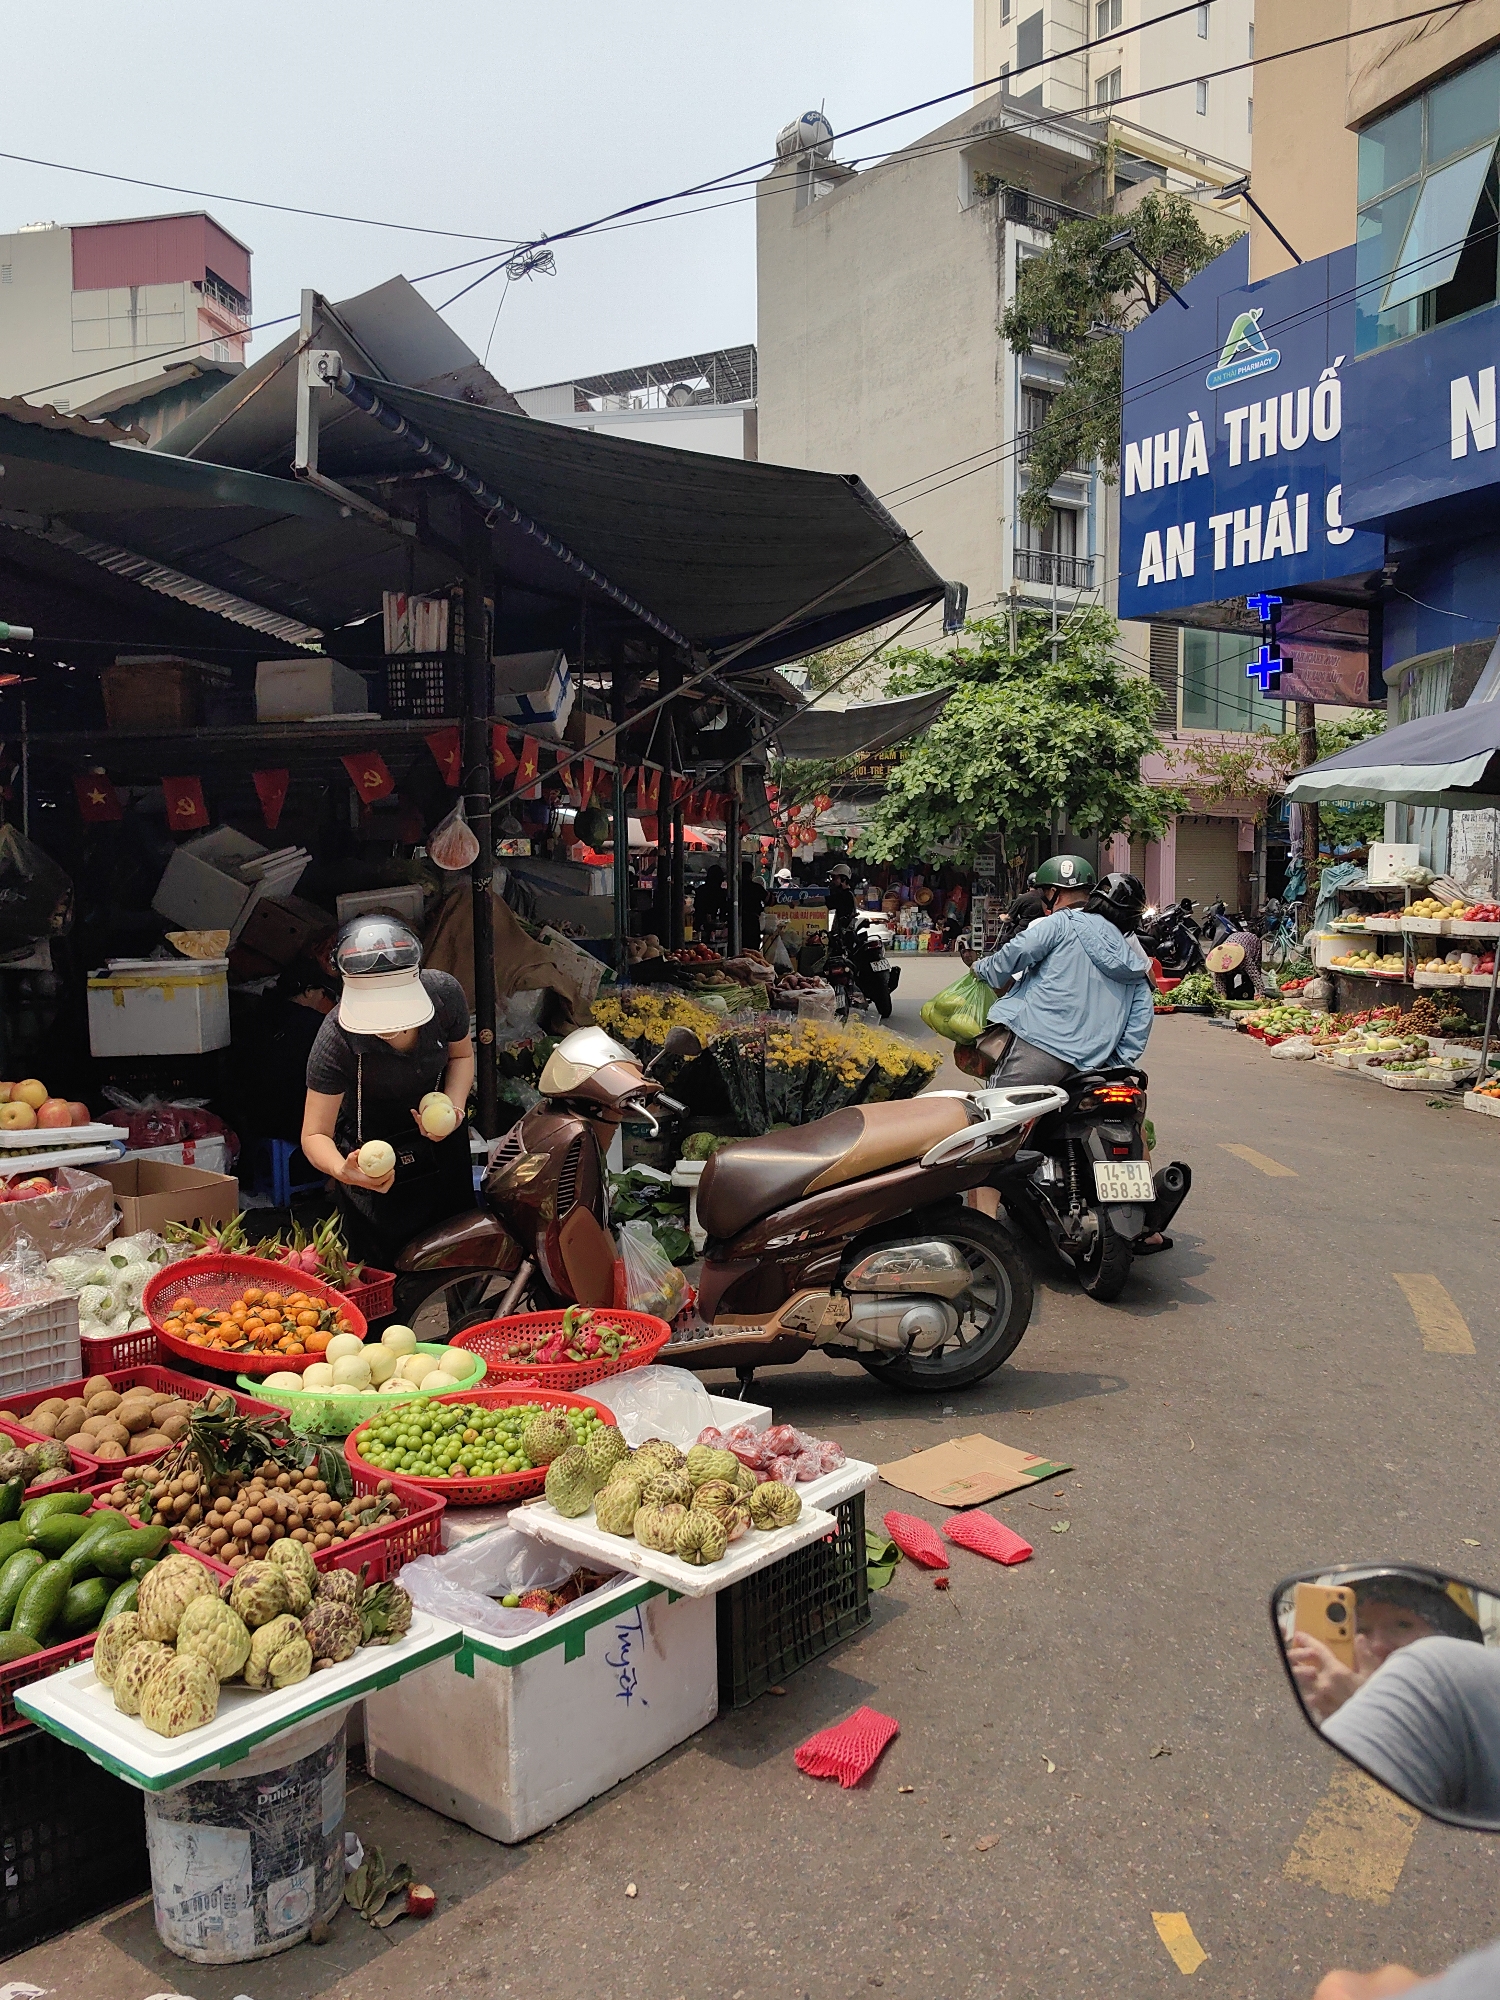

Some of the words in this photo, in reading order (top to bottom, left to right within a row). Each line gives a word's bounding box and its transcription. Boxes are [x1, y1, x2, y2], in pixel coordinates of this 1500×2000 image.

[1213, 374, 1222, 384] AN
[1223, 369, 1237, 380] THÁI
[1237, 357, 1273, 375] PHARMACY
[1124, 410, 1210, 497] NHÀ
[1137, 520, 1196, 588] AN
[1208, 484, 1309, 571] THÁI
[1326, 483, 1355, 545] 9
[1103, 1164, 1143, 1181] 14-B1
[1100, 1182, 1151, 1199] 858.33
[257, 1784, 297, 1805] Dulux
